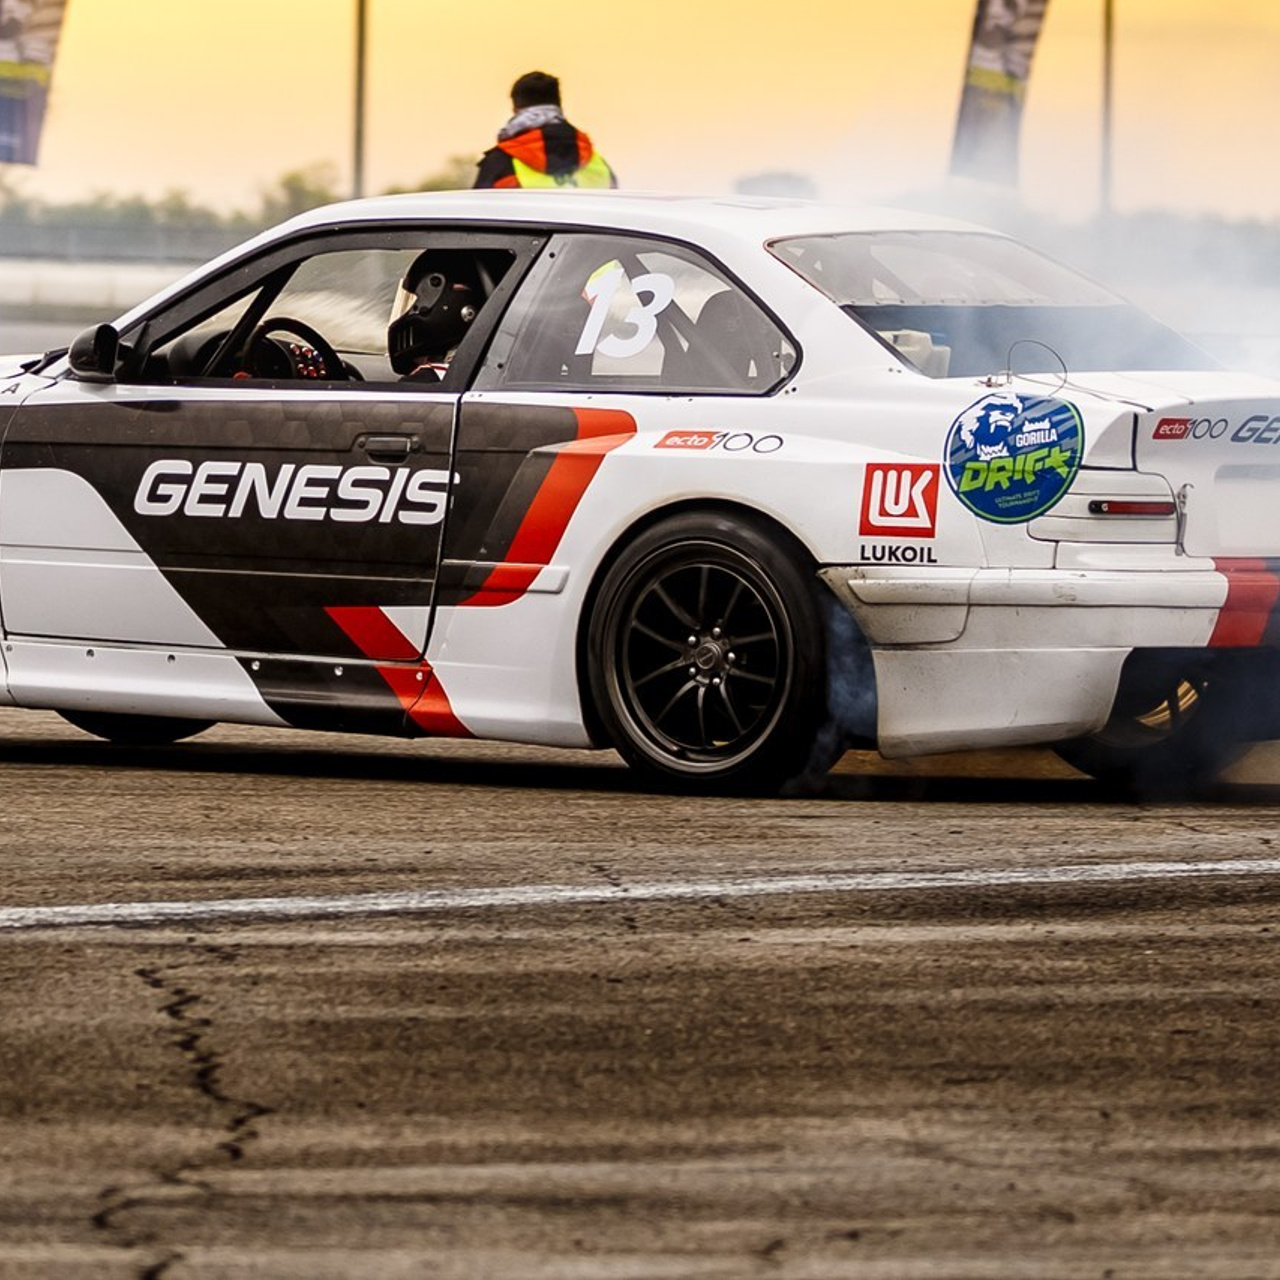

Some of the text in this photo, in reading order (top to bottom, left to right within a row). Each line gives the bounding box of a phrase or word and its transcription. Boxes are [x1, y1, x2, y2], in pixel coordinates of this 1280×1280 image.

[574, 266, 676, 358] 13
[1016, 428, 1058, 447] GORILLA
[134, 459, 460, 525] GENESIS
[860, 545, 938, 563] LUKOIL
